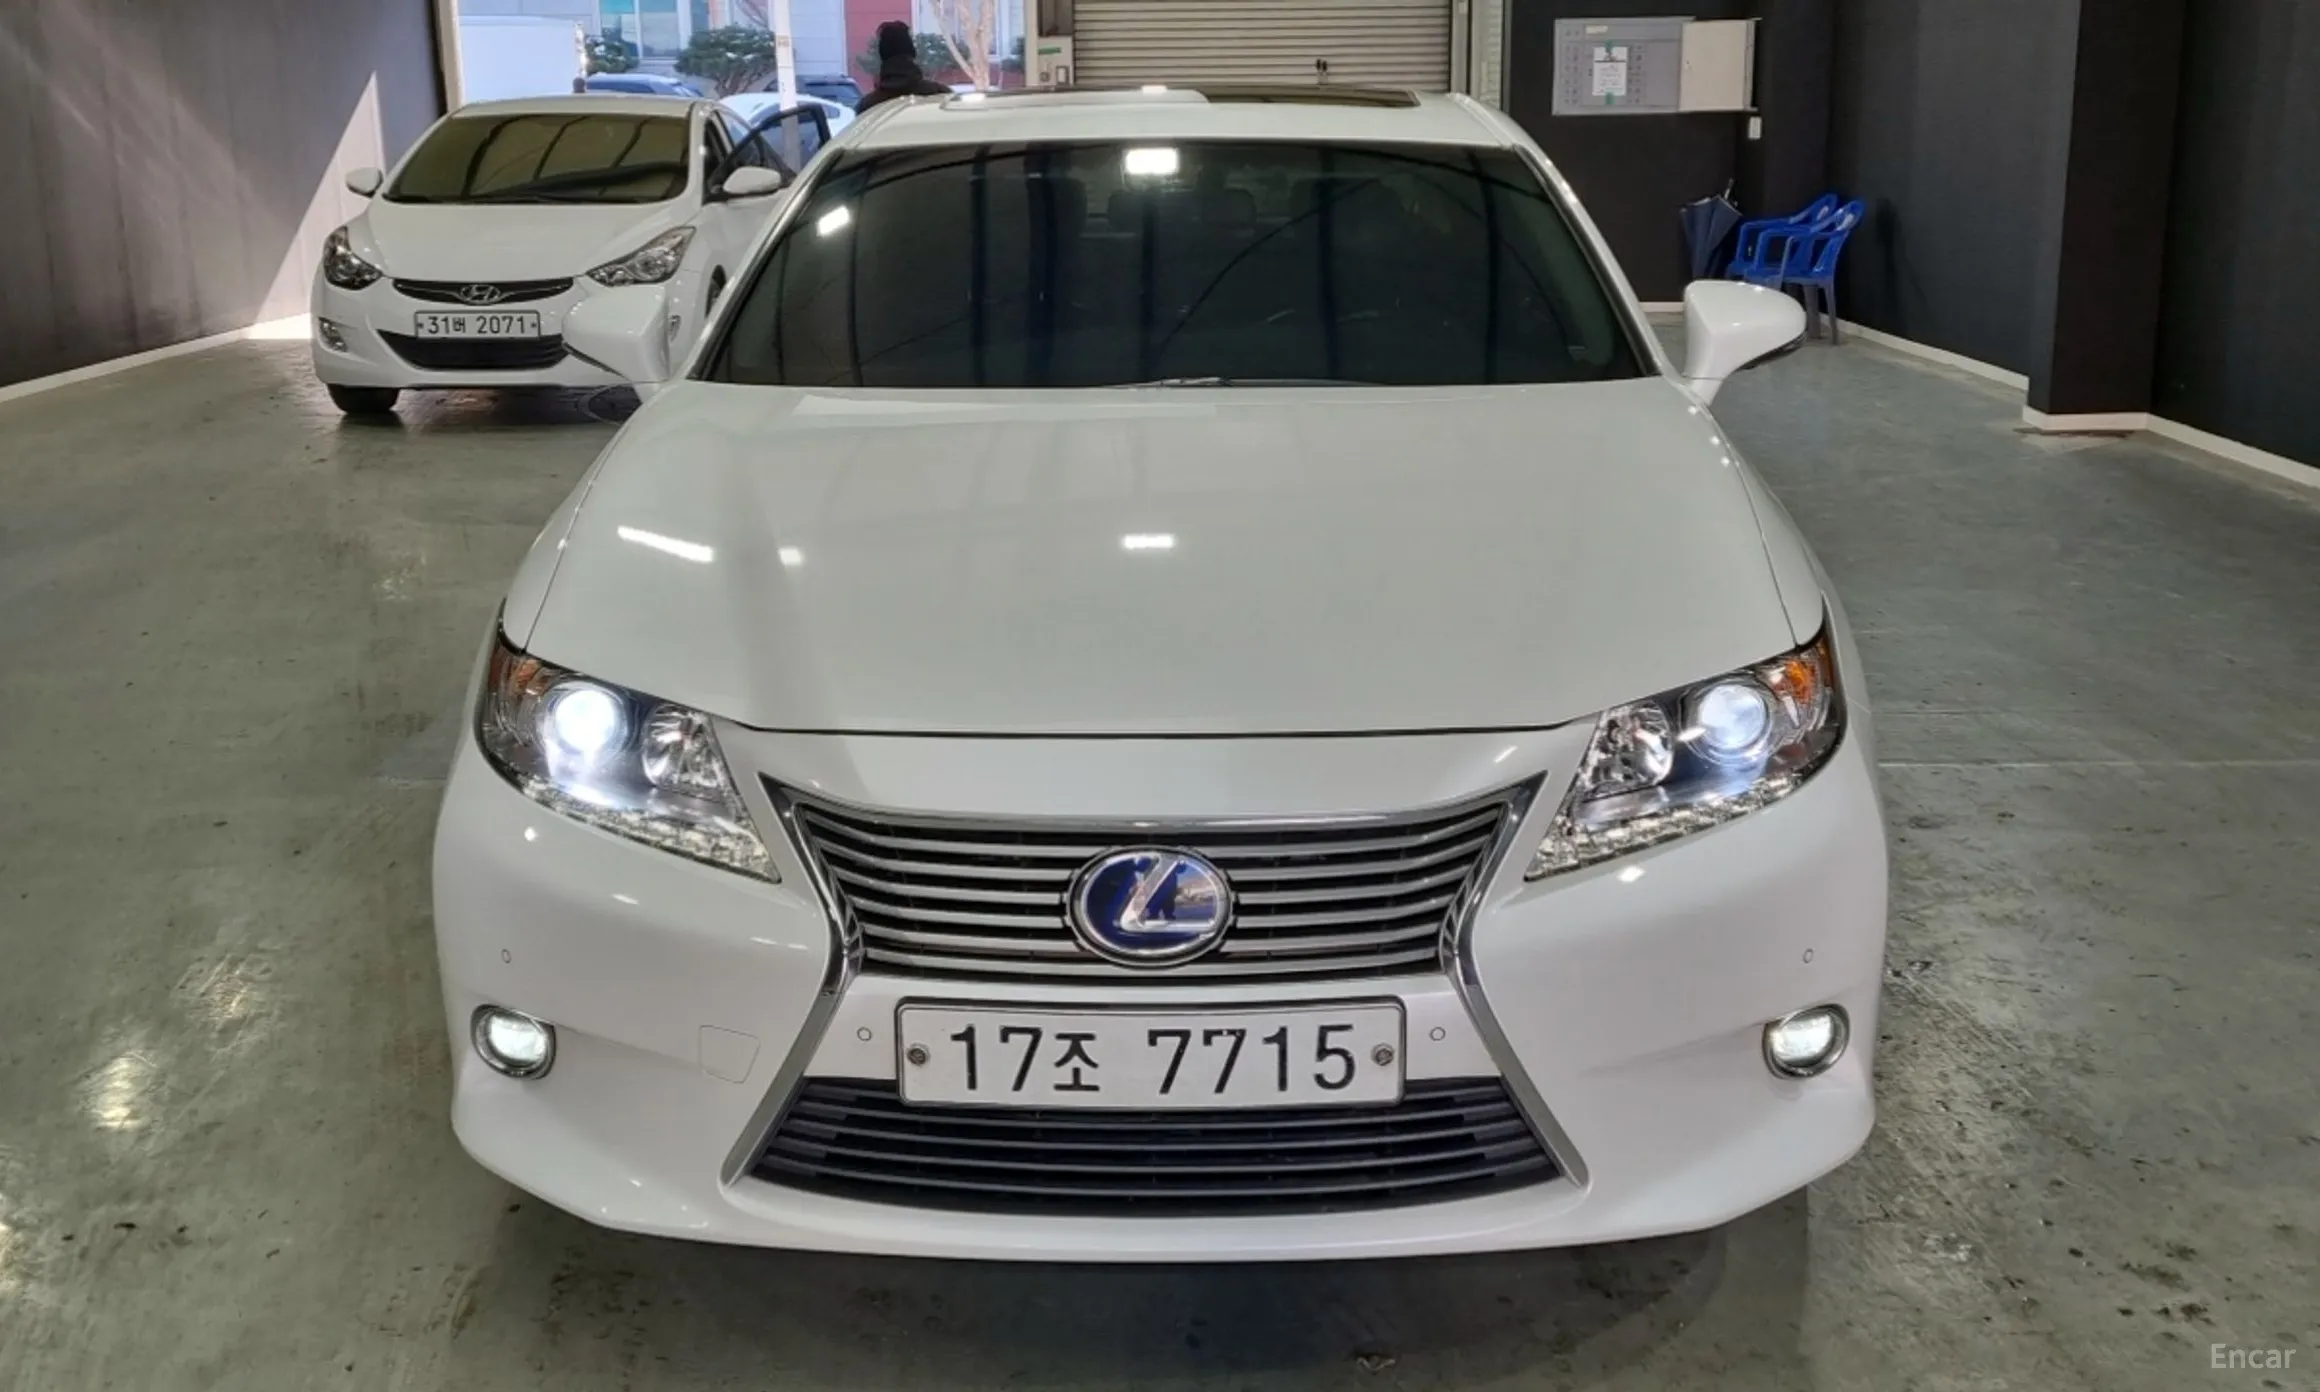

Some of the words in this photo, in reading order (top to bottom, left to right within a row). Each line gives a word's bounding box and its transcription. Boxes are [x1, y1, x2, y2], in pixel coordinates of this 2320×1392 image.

[476, 315, 526, 334] 2071
[950, 1023, 1100, 1092] 17조
[1146, 1023, 1357, 1095] 7715
